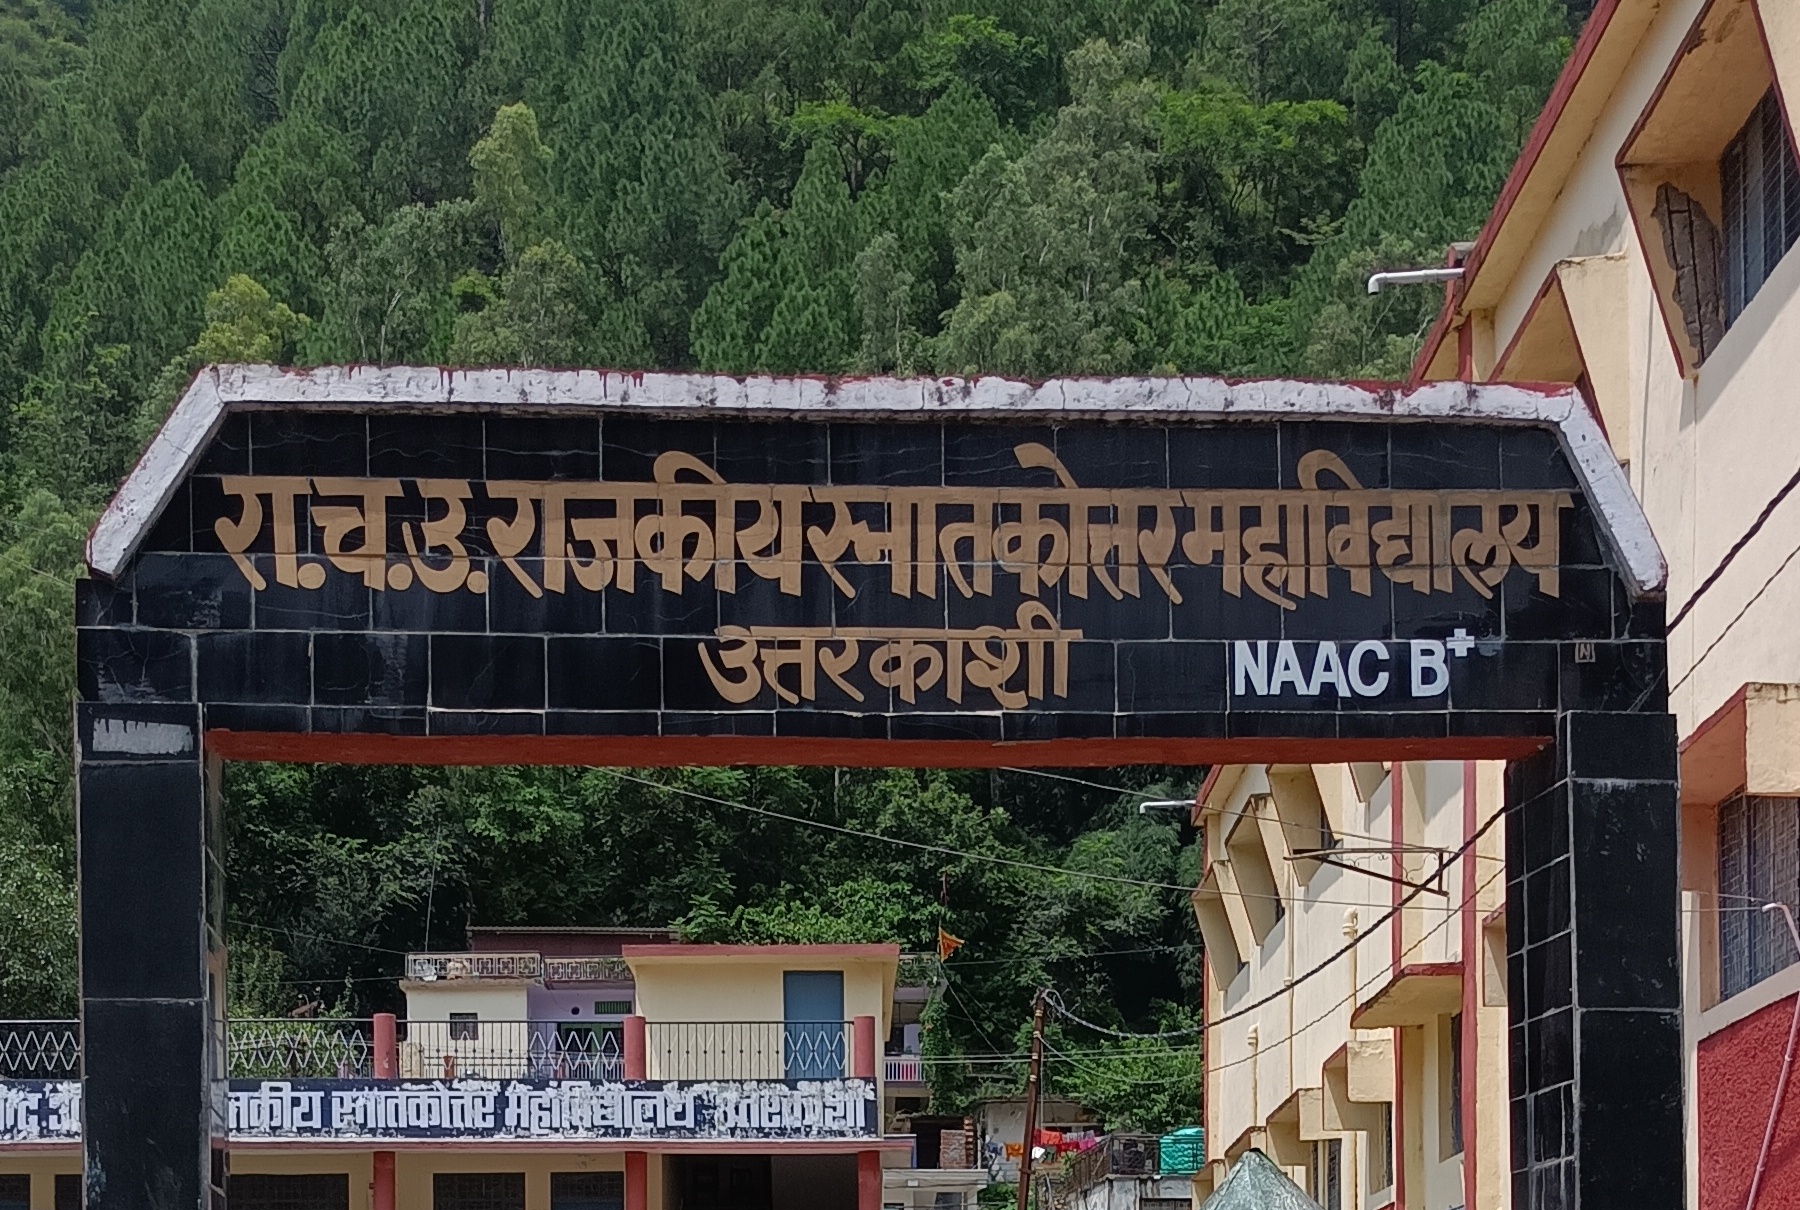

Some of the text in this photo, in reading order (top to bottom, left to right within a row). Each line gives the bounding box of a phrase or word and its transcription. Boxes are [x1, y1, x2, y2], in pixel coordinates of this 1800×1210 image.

[487, 451, 808, 599] राजकीय
[806, 442, 1187, 605] स्नातकोत्तर
[1181, 449, 1575, 612] महाविद्यालय
[698, 600, 1084, 709] उत्तरकाशी
[1234, 628, 1476, 698] NAAC B+
